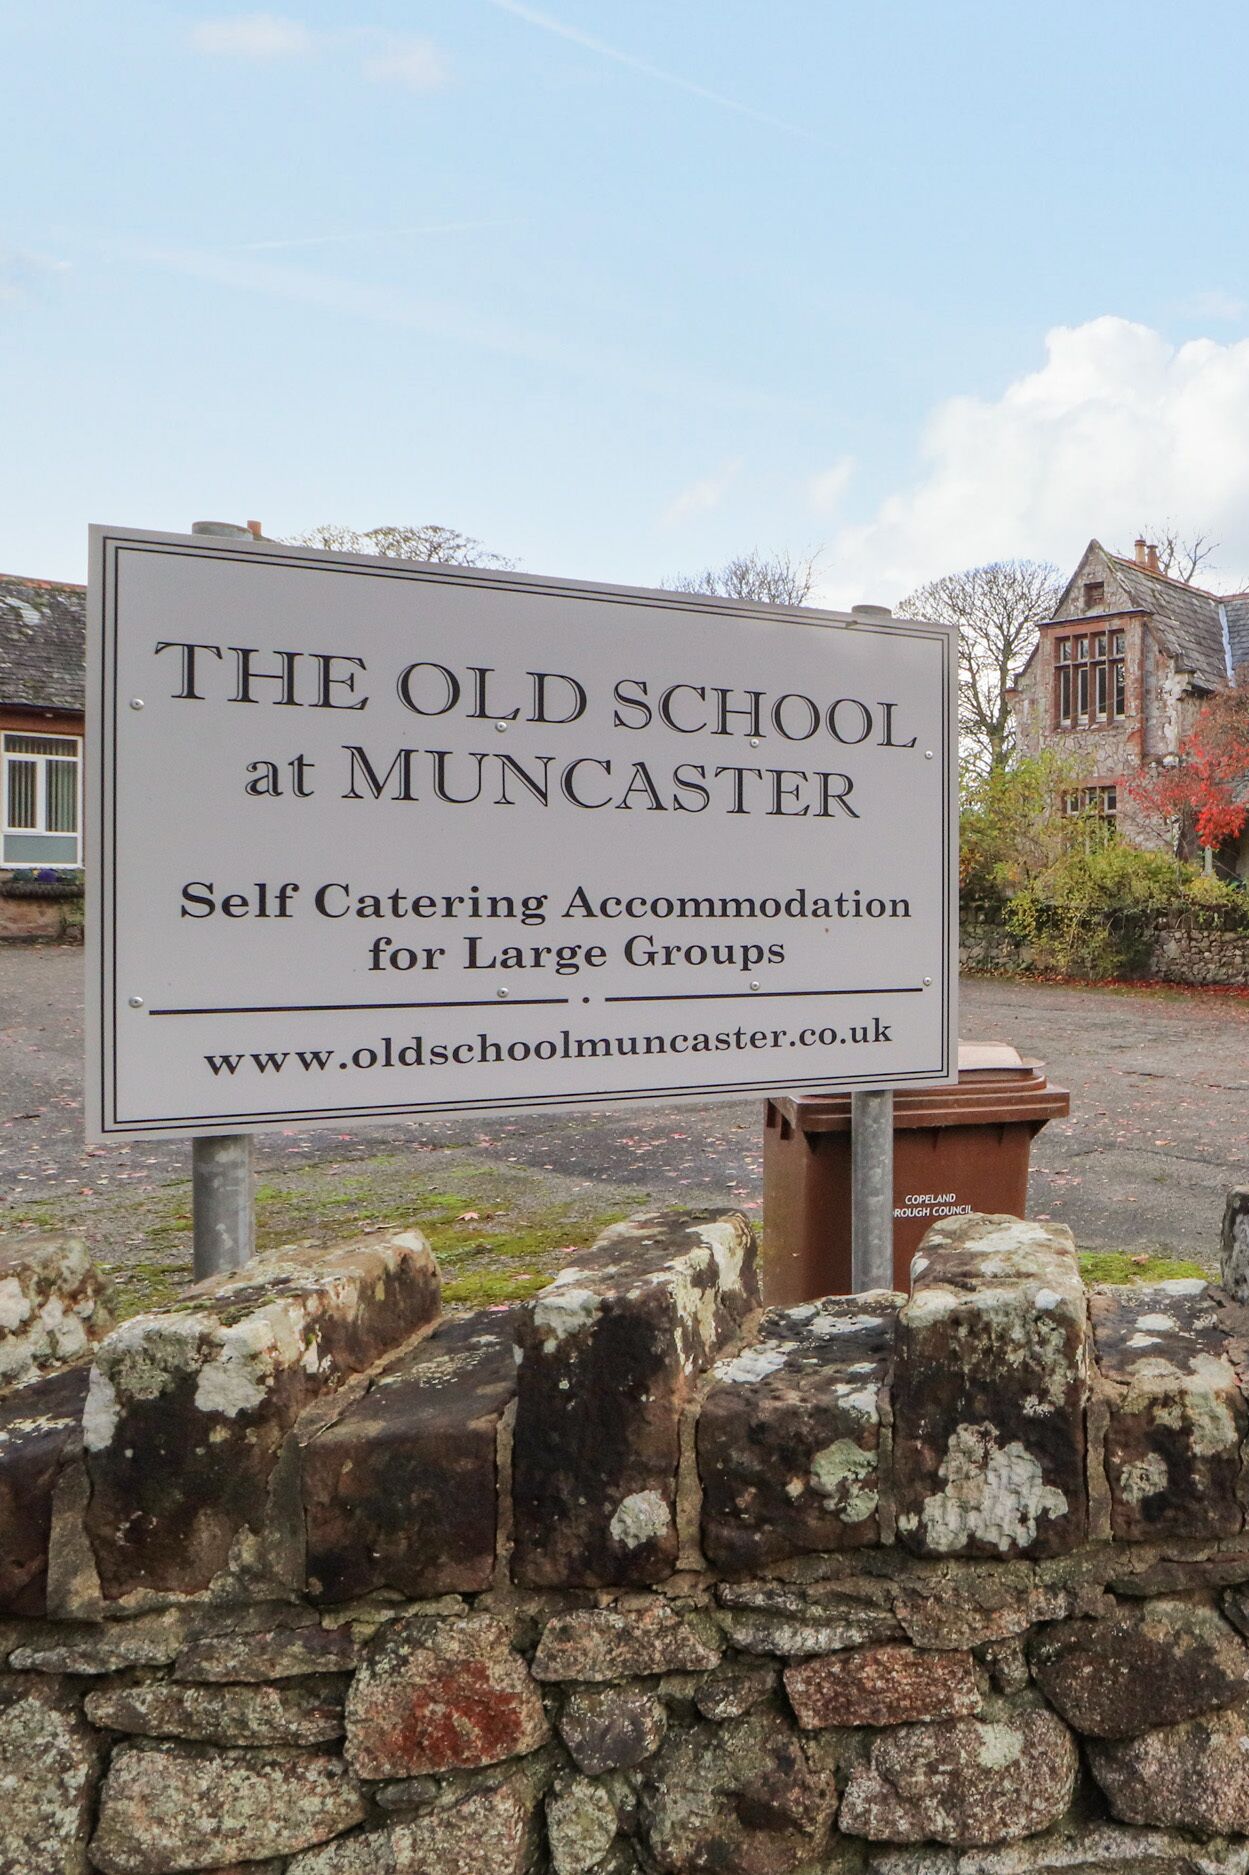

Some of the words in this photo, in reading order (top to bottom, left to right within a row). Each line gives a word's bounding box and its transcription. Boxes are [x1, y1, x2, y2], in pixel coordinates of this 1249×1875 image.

[155, 641, 370, 711] THE
[396, 662, 588, 725] OLD
[613, 679, 918, 749] SCHOOL
[244, 752, 315, 799] at
[341, 745, 862, 820] MUNCASTER
[180, 881, 300, 919] Self
[314, 883, 549, 927] Catering
[562, 885, 912, 919] Accommodation
[367, 936, 446, 971] for
[463, 936, 607, 976] Large
[623, 934, 786, 972] Groups
[203, 1017, 893, 1077] www.oldschoolmuncaster.co.uk
[893, 1207, 930, 1218] ROUGH
[932, 1204, 973, 1216] COUNCIL
[905, 1193, 956, 1205] COPELAND
